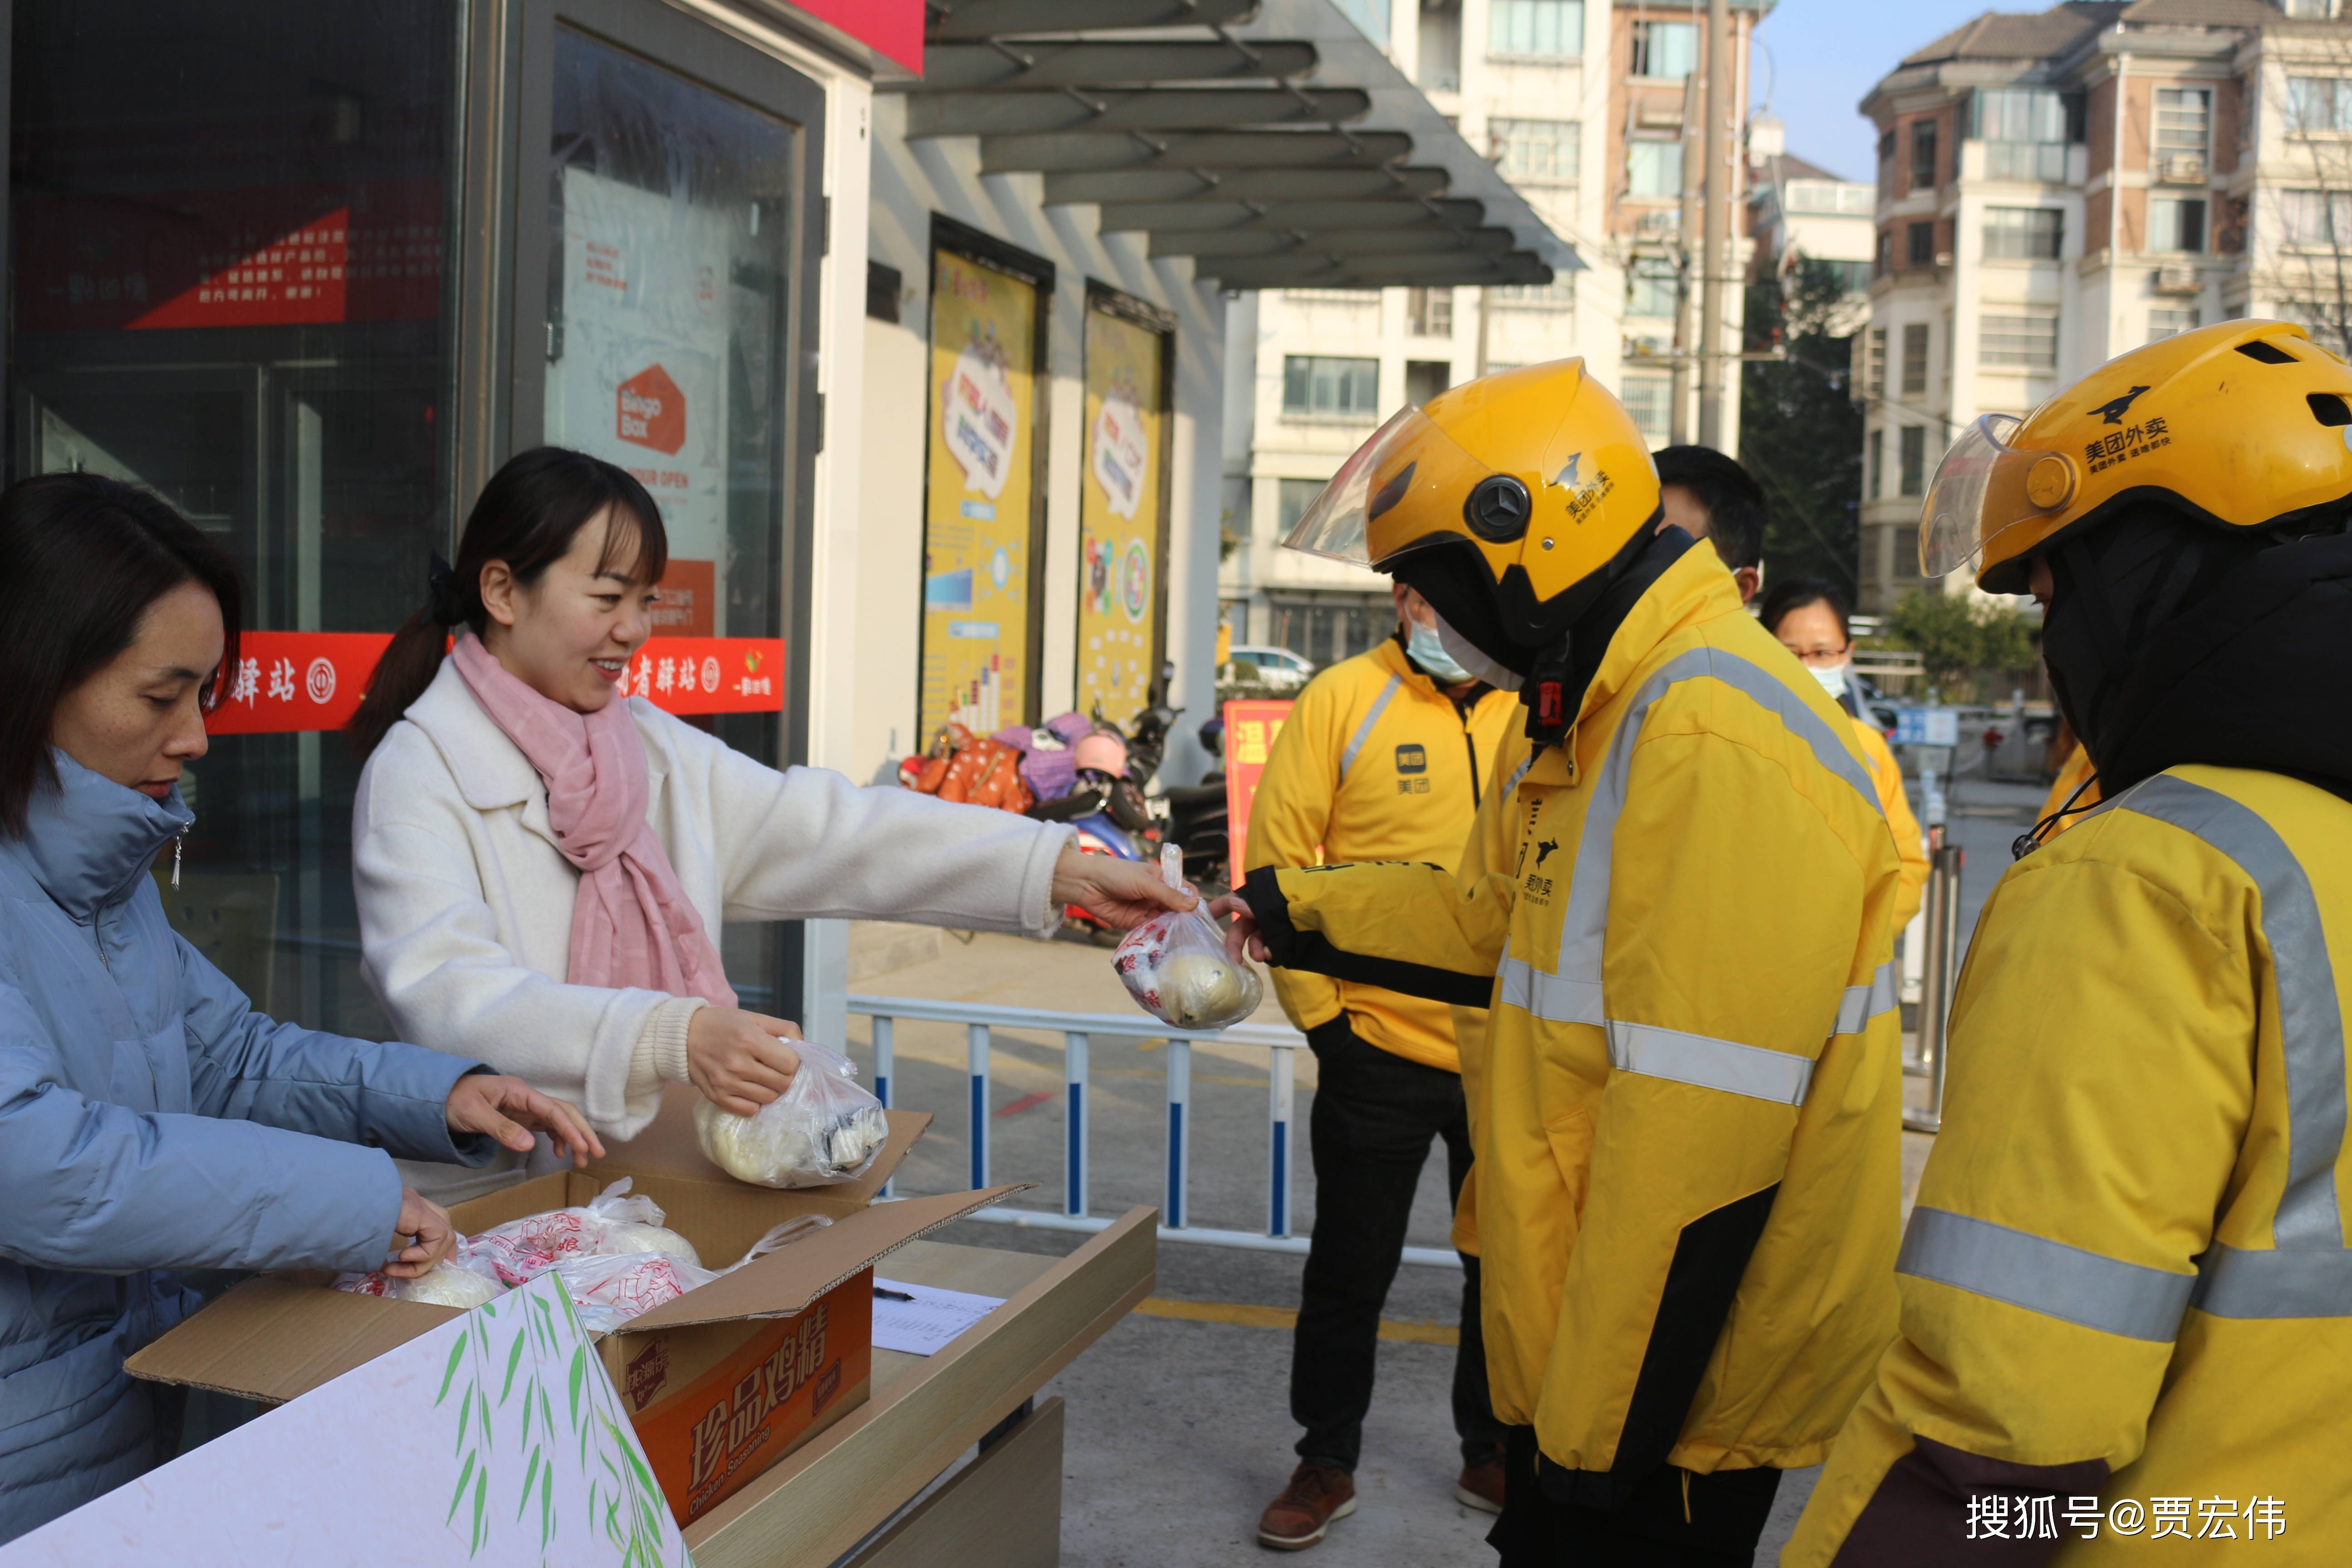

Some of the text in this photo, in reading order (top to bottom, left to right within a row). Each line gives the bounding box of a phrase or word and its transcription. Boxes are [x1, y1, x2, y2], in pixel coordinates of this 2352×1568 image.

[621, 388, 661, 419] Bingo
[621, 414, 648, 438] Box
[2084, 417, 2168, 464] 美团外卖
[2089, 436, 2172, 475] 美团外卖 送啥都快
[1566, 470, 1610, 519] 美团外卖
[205, 657, 295, 710] 驿站
[1397, 751, 1424, 766] 美团
[1397, 779, 1430, 795] 美团
[688, 1301, 828, 1494] 珍品鸡精
[689, 1423, 770, 1517] Chicken Seasoning
